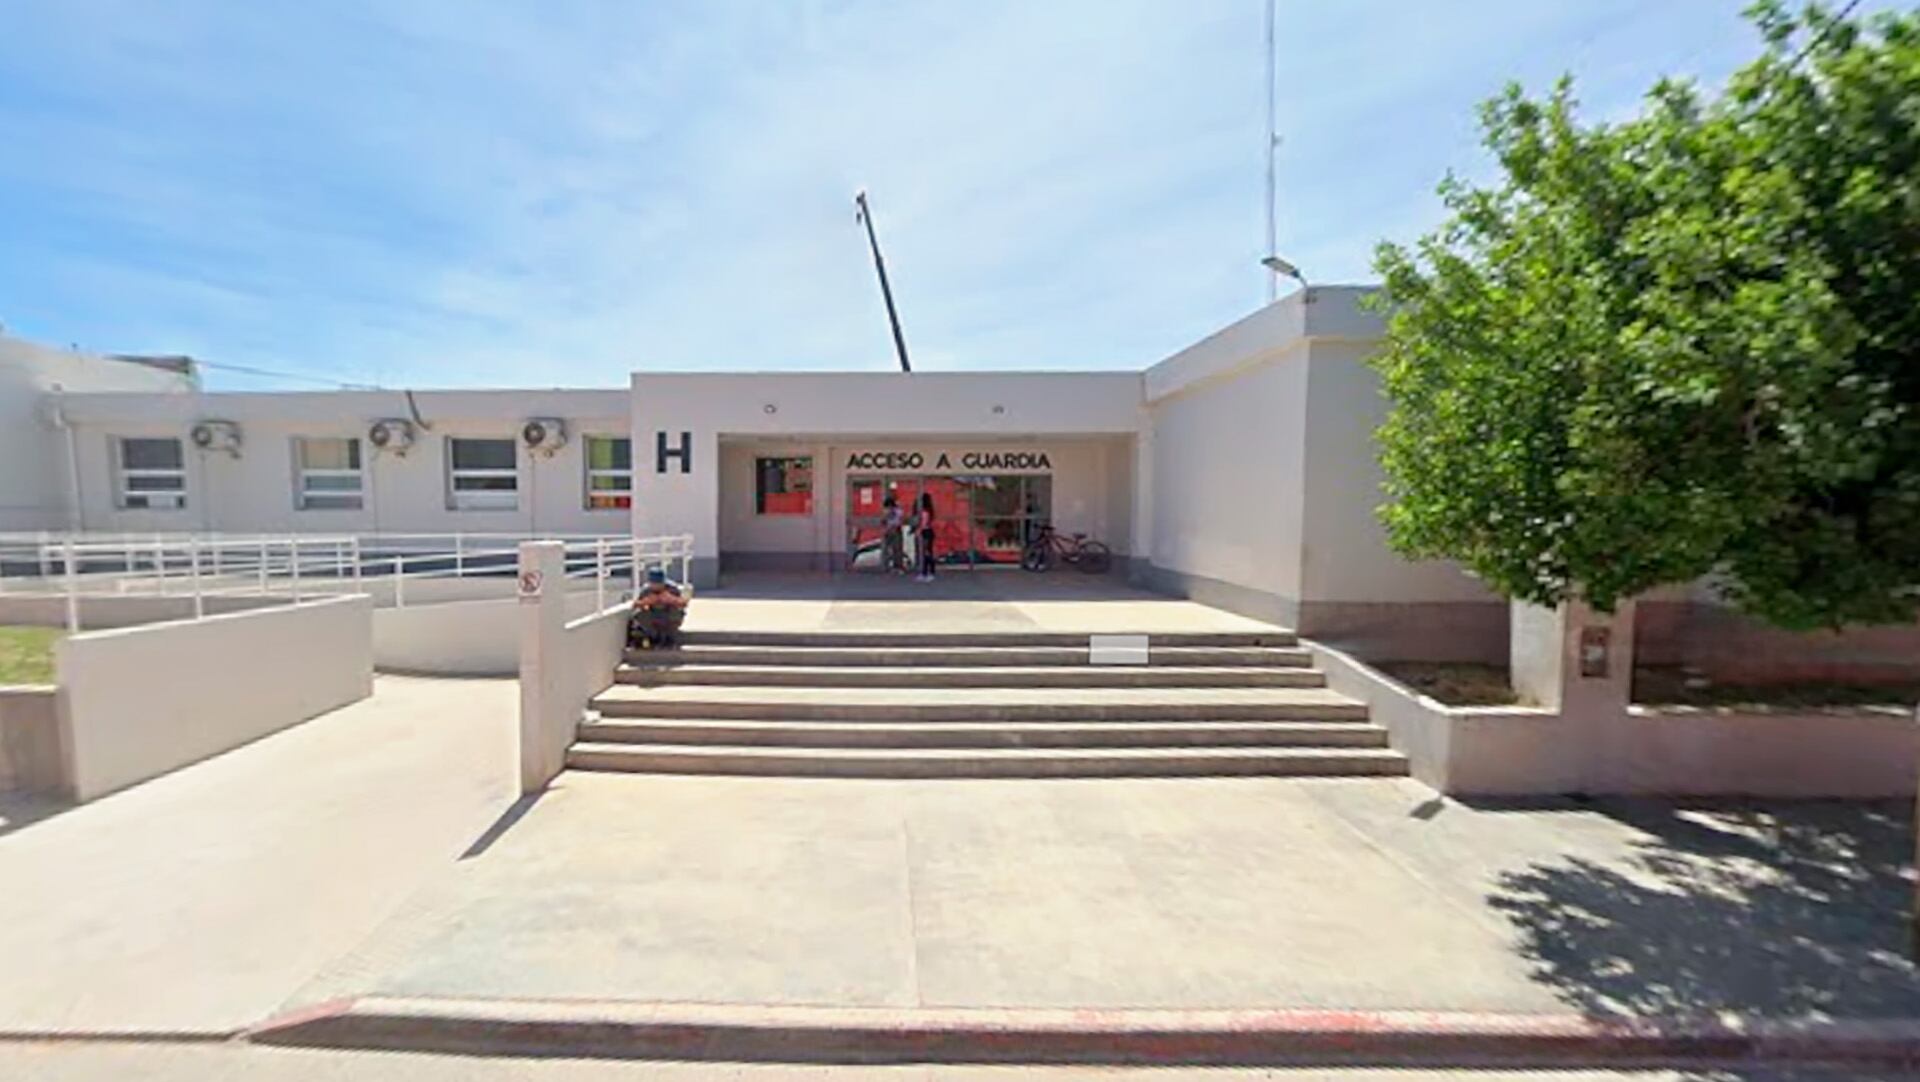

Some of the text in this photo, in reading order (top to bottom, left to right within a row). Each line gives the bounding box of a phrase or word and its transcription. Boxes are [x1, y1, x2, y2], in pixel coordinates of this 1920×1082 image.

[657, 432, 691, 473] H
[847, 453, 1051, 469] ACCESO A GUARDIA
